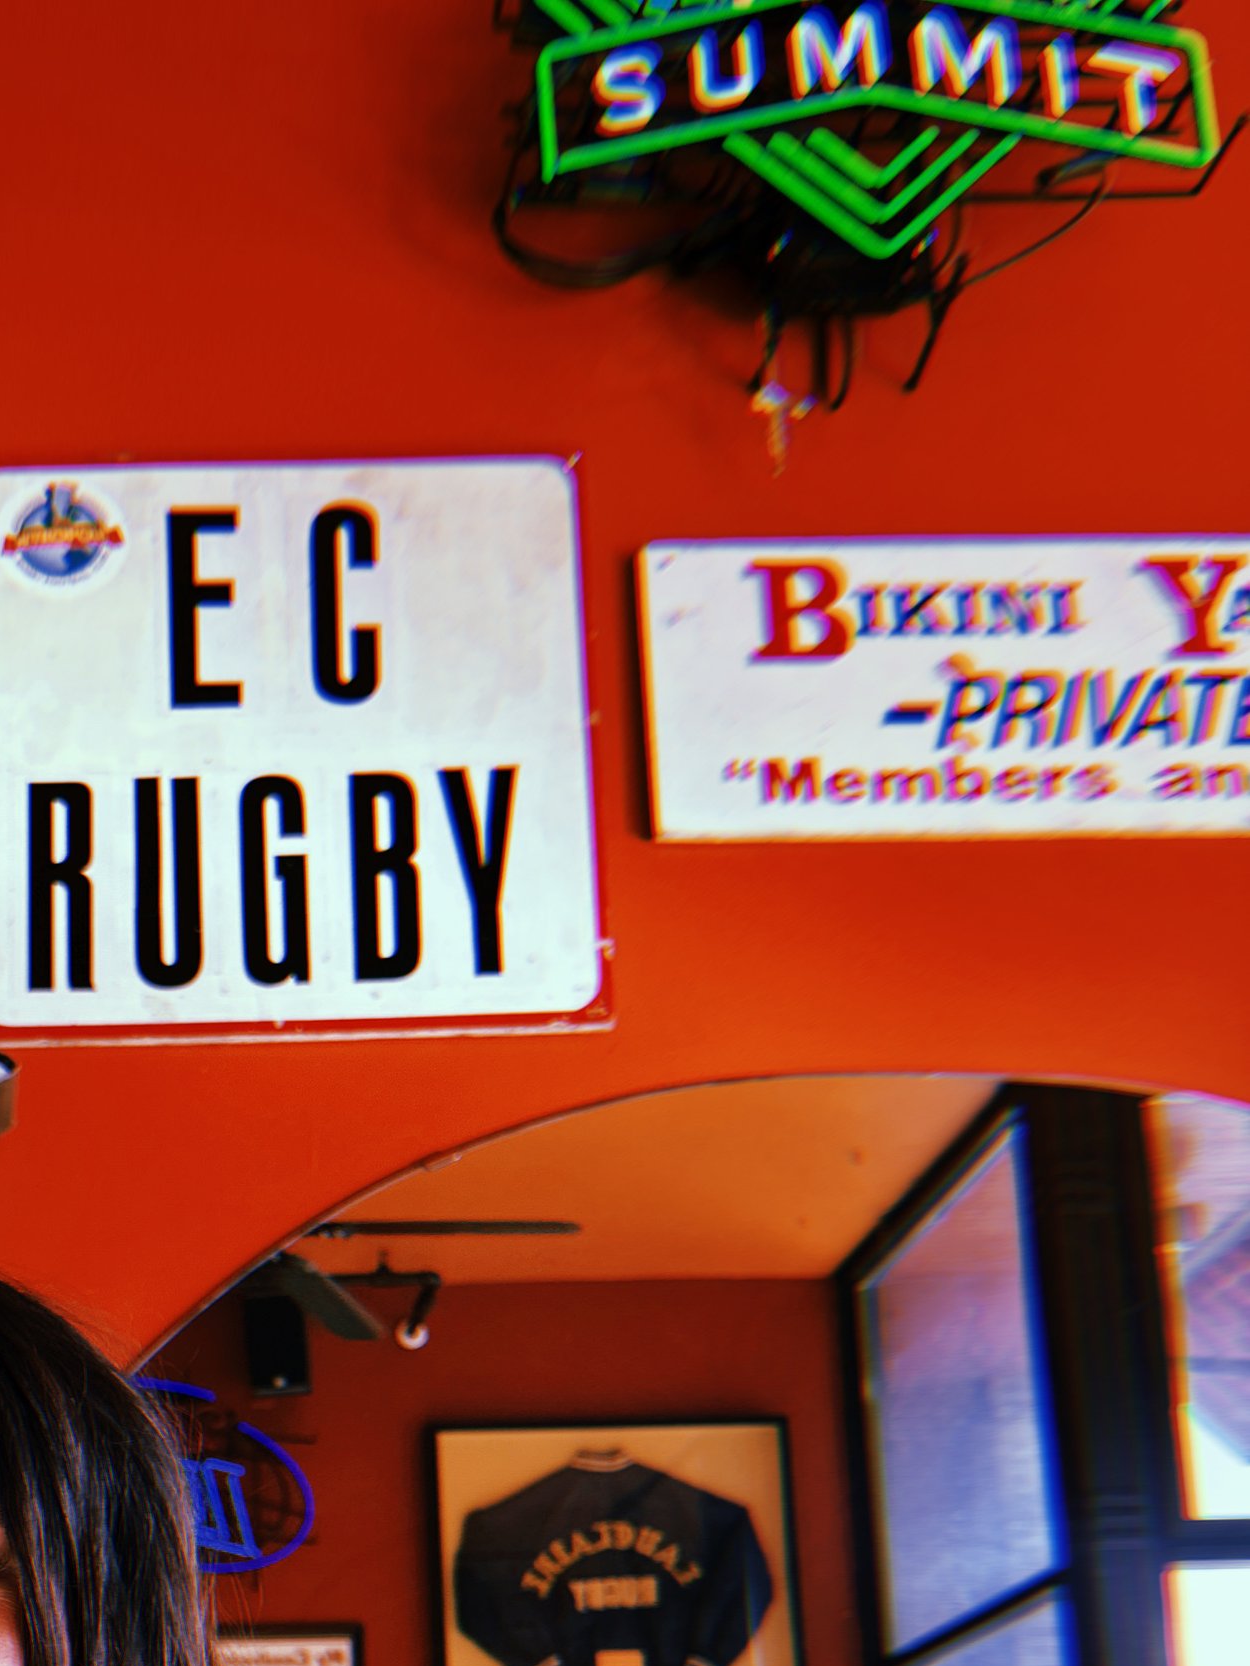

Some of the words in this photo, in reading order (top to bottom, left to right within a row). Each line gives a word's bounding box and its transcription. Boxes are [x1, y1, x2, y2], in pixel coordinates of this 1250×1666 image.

[591, 0, 1182, 137] SUMMIT
[740, 556, 1090, 665] BIKINI
[26, 763, 520, 993] RUGBY
